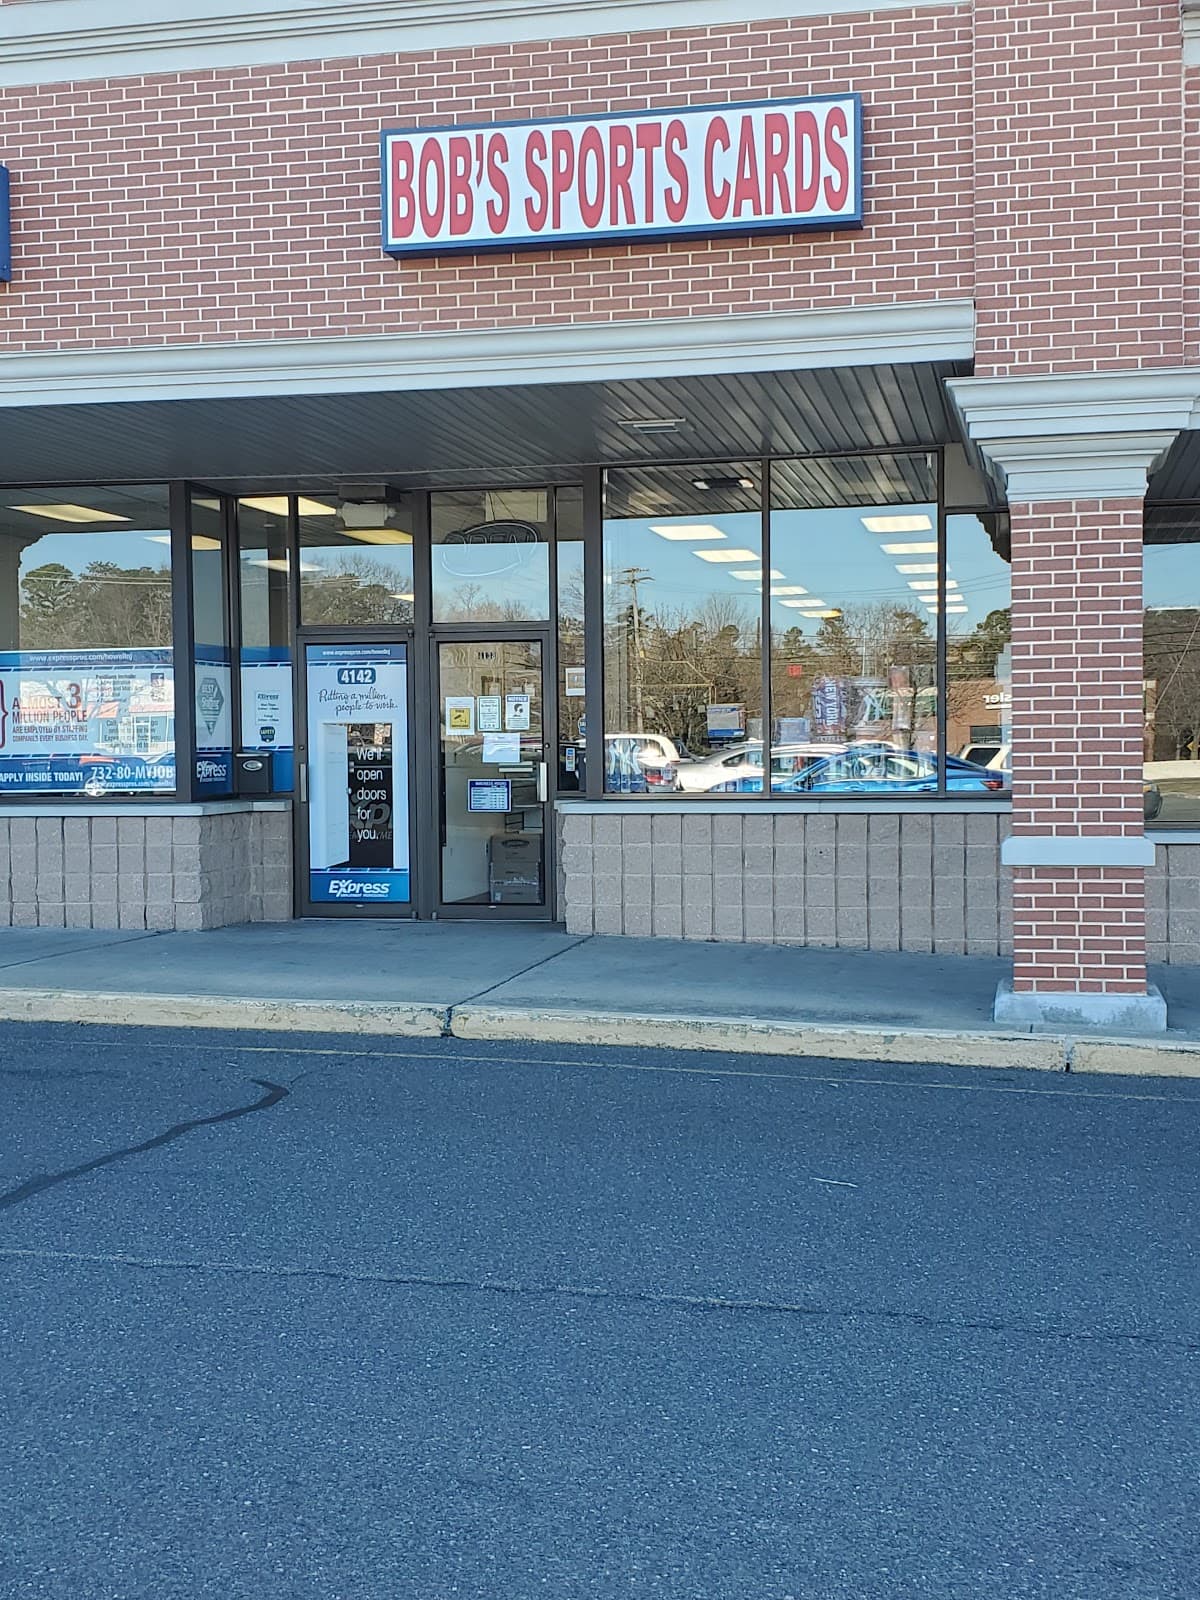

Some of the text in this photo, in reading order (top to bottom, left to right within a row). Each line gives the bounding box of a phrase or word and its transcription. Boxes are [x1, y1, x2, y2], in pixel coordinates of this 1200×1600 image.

[391, 106, 850, 239] BOB'S SPORTS CARDS
[341, 669, 372, 683] 4142
[12, 696, 62, 710] ALMOST
[66, 683, 82, 709] 3
[319, 689, 349, 704] Putting
[359, 686, 388, 700] million
[336, 700, 361, 716] people
[363, 700, 374, 710] to
[12, 710, 88, 724] MILLION PEOPLE
[356, 747, 383, 761] We'll
[25, 772, 52, 782] INSIDE
[54, 771, 83, 782] TODAY!
[91, 765, 174, 779] 732-80-MYJOB
[356, 769, 383, 783] open
[356, 787, 387, 800] doors
[357, 806, 371, 820] for
[357, 829, 379, 842] you.
[328, 879, 391, 898] Express
